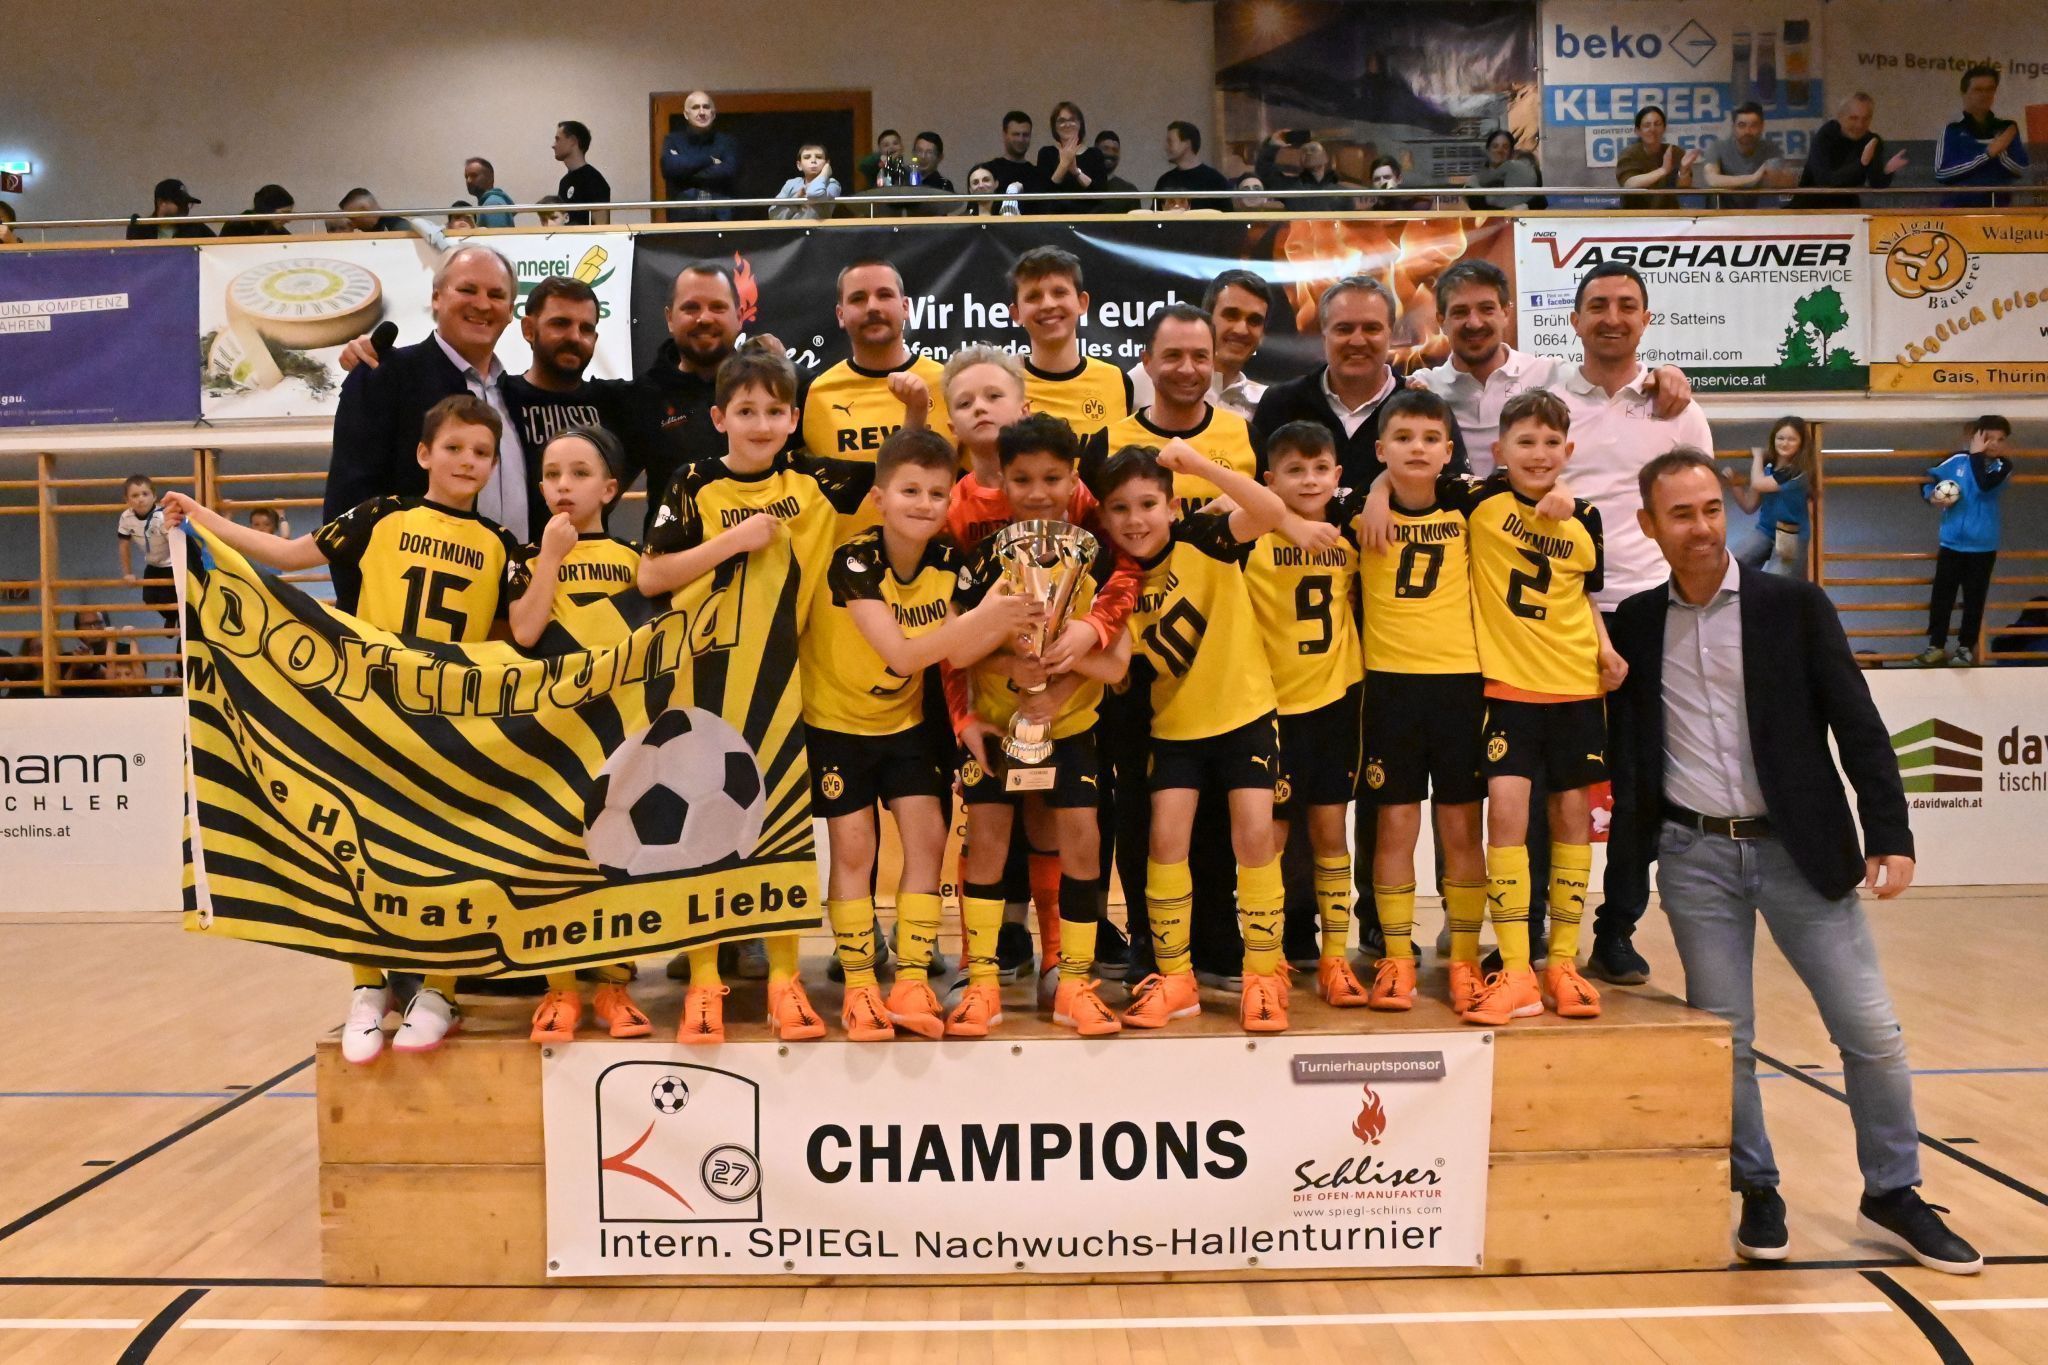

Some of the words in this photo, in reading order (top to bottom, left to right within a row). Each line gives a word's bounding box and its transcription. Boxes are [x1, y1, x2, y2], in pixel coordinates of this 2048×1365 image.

[1556, 24, 1662, 59] beko
[1857, 53, 1898, 70] wpa
[1532, 236, 1852, 269] VASCHAUNER
[516, 255, 570, 278] nnerei
[1715, 271, 1725, 284] &
[1729, 269, 1853, 284] GARTENSERVICE
[1928, 256, 1980, 309] Bäckerei
[1, 303, 31, 317] UND
[37, 296, 123, 313] KOMPETENZ
[1534, 314, 1569, 327] Brühl
[1670, 312, 1726, 325] Satteins
[1534, 333, 1568, 346] 0664
[1933, 369, 1980, 385] Gais,
[1394, 521, 1460, 544] ORTMUND
[399, 532, 485, 571] DORTMUND
[558, 562, 632, 584] ORTMUND
[1506, 547, 1552, 621] 2
[400, 565, 473, 643] 15
[1295, 575, 1334, 656] 9
[201, 554, 748, 717] Dortmund
[1142, 596, 1208, 679] 10
[1998, 724, 2048, 766] da
[823, 774, 841, 791] BVB
[1998, 771, 2048, 792] tischl
[307, 803, 499, 930] Heimat,
[522, 908, 662, 951] meine
[688, 880, 809, 924] Liebe
[1299, 1059, 1441, 1074] Turnierhauptsponsor
[805, 1119, 1249, 1186] CHAMPIONS
[712, 1160, 749, 1187] 27
[1293, 1194, 1312, 1203] DIE
[600, 1228, 731, 1258] Intern.
[747, 1228, 900, 1259] SPIEGL
[914, 1219, 1442, 1259] Nachwuchs-Hallenturnier
